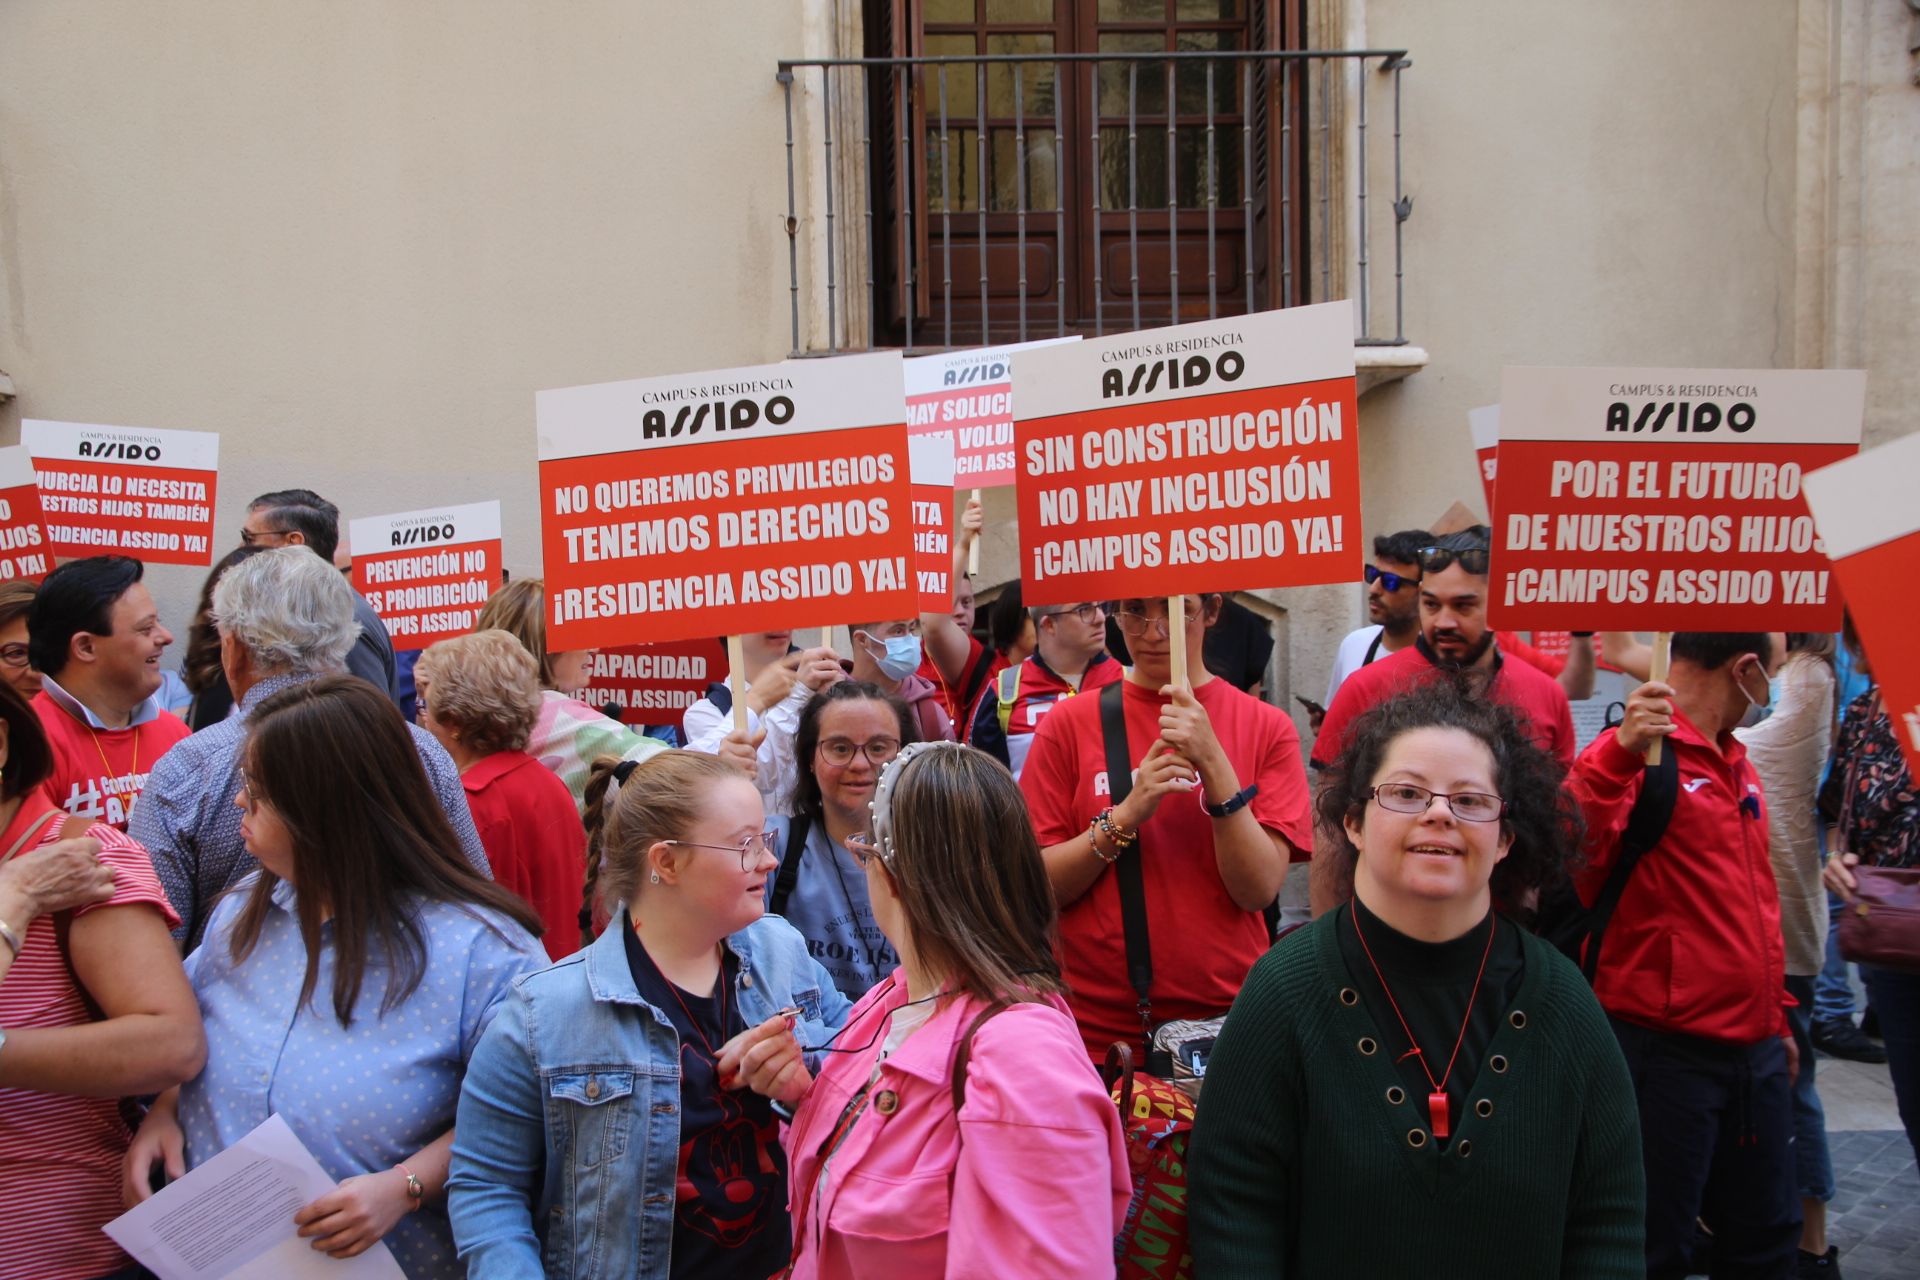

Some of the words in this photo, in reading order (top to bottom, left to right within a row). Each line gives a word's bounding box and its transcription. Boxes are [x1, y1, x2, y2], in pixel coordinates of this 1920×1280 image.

[1102, 344, 1152, 363] CAMPUS
[1155, 344, 1164, 354] &
[1166, 332, 1244, 354] RESIDENCIA
[944, 362, 1011, 386] ASSID
[1102, 351, 1245, 398] ASSIDO
[642, 388, 698, 404] CAMPUS
[700, 386, 710, 398] &
[712, 378, 794, 396] RESIDENCIA
[1609, 383, 1664, 398] CAMPUS
[1666, 385, 1676, 397] &
[1678, 384, 1758, 398] RESIDENCIA
[642, 396, 795, 440] ASSIDO
[1605, 402, 1756, 434] ASSIDO
[79, 441, 161, 461] ASSIDO
[80, 432, 111, 440] CAMPUS
[118, 434, 162, 444] RESIDENCIA
[1026, 435, 1075, 477] SIN
[1082, 397, 1343, 470] CONSTRUCCIÓN
[954, 455, 983, 474] CIA
[102, 476, 122, 495] LO
[126, 478, 206, 501] NECESITA
[555, 485, 589, 515] NO
[595, 469, 730, 512] QUEREMOS
[736, 453, 895, 497] PRIVILEGIOS
[1039, 487, 1078, 527] NO
[1086, 480, 1144, 522] HAY
[1151, 455, 1331, 516] INCLUSIÓN
[1550, 460, 1620, 499] POR
[1626, 460, 1661, 499] EL
[1669, 462, 1801, 500] FUTURO
[40, 495, 98, 515] ESTROS
[101, 500, 142, 518] HIJOS
[146, 502, 210, 523] TAMBIÉN
[420, 514, 454, 525] RESIDENCIA
[120, 531, 180, 551] ASSIDO
[184, 535, 208, 552] YA!
[392, 524, 455, 546] ASSIDO
[563, 514, 711, 564] TENEMOS
[718, 497, 890, 549] DERECHOS
[1506, 514, 1551, 552] DE
[1556, 514, 1732, 554] NUESTROS
[1033, 531, 1162, 581] ¡CAMPUS
[1168, 520, 1285, 566] ASSIDO
[1291, 514, 1344, 555] YA!
[16, 554, 47, 577] YA!
[366, 550, 460, 584] PREVENCIÓN
[464, 550, 486, 573] NO
[386, 577, 488, 612] PROHIBICIÓN
[554, 572, 736, 626] ¡RESIDENCIA
[741, 562, 852, 604] ASSIDO
[858, 556, 907, 593] YA!
[916, 570, 947, 594] YA!
[1504, 568, 1650, 607] ¡CAMPUS
[1654, 570, 1774, 605] ASSIDO
[1780, 570, 1830, 604] YA!
[421, 610, 472, 634] ASSIDO
[630, 689, 698, 709] ASSIDO
